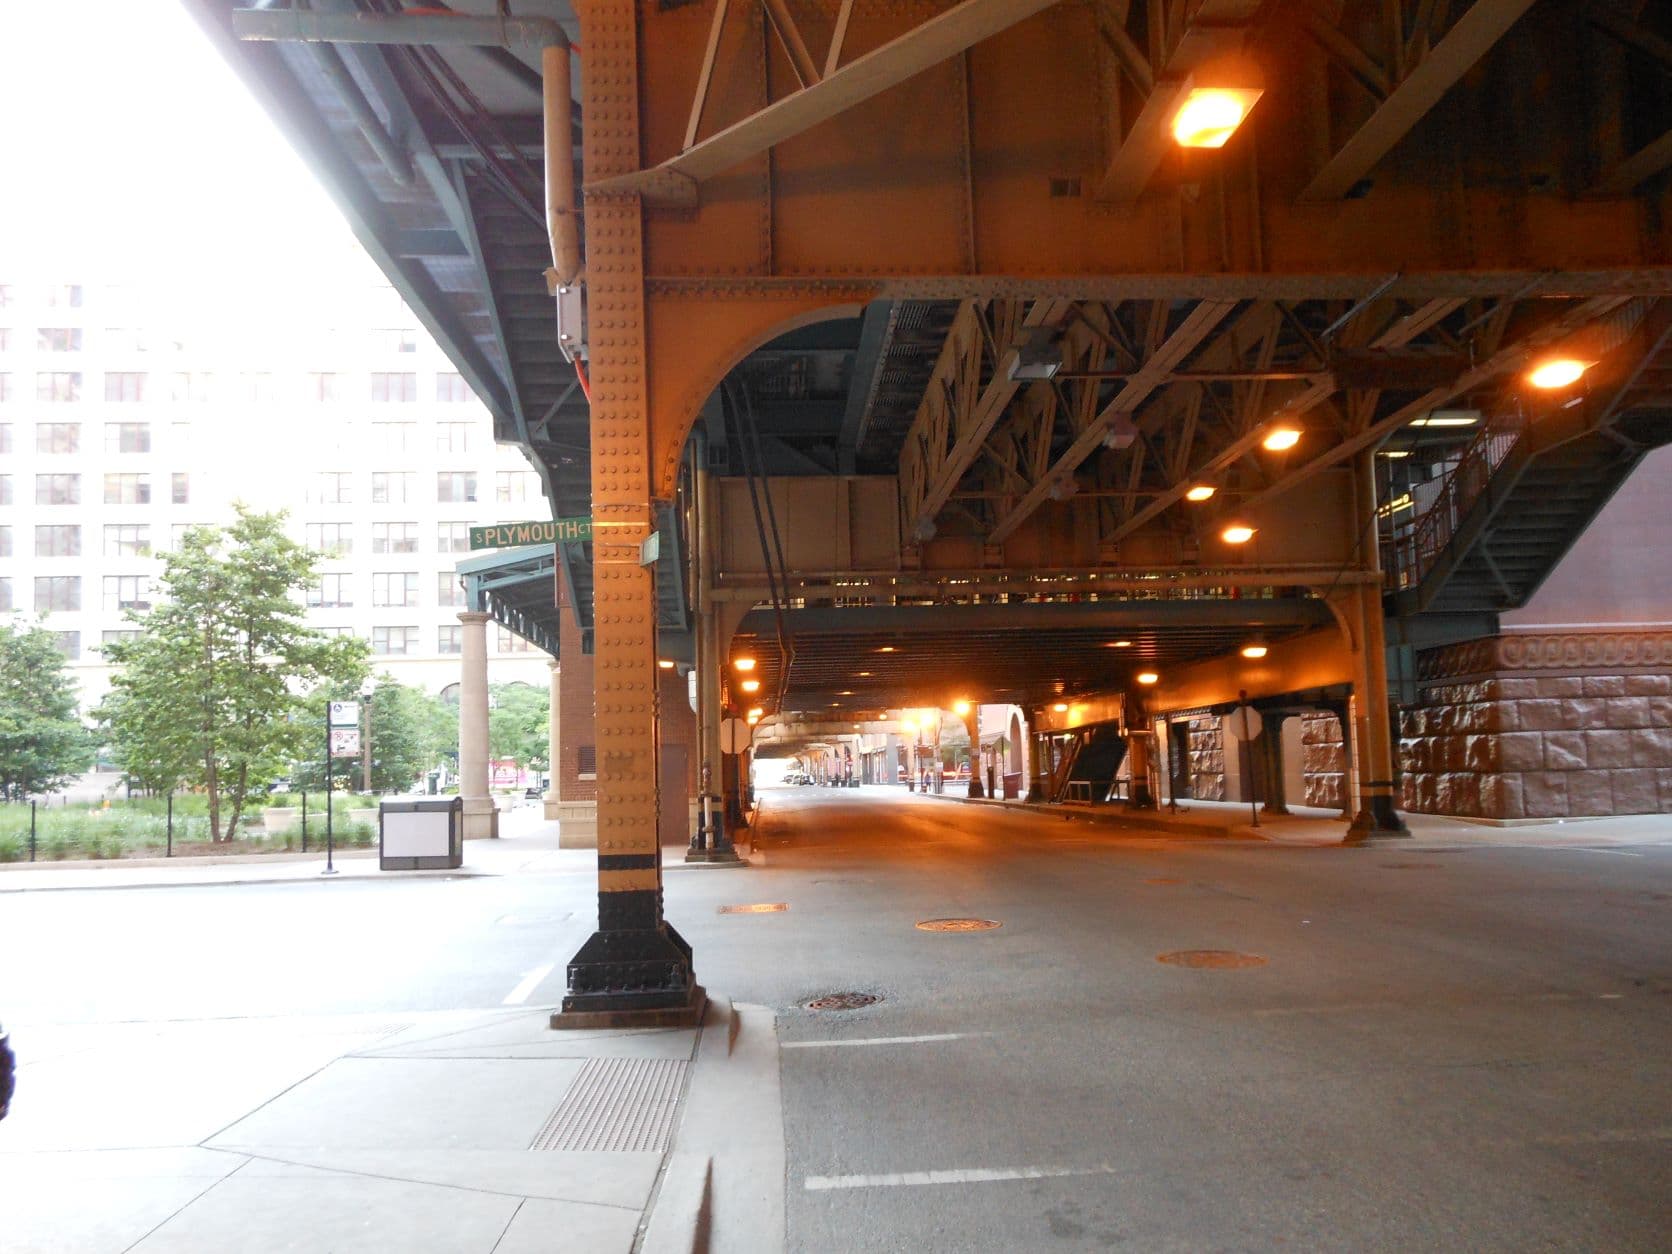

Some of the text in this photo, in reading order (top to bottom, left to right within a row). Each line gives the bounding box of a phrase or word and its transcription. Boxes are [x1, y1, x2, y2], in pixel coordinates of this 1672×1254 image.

[476, 521, 592, 546] S PLYMOUTH CT
